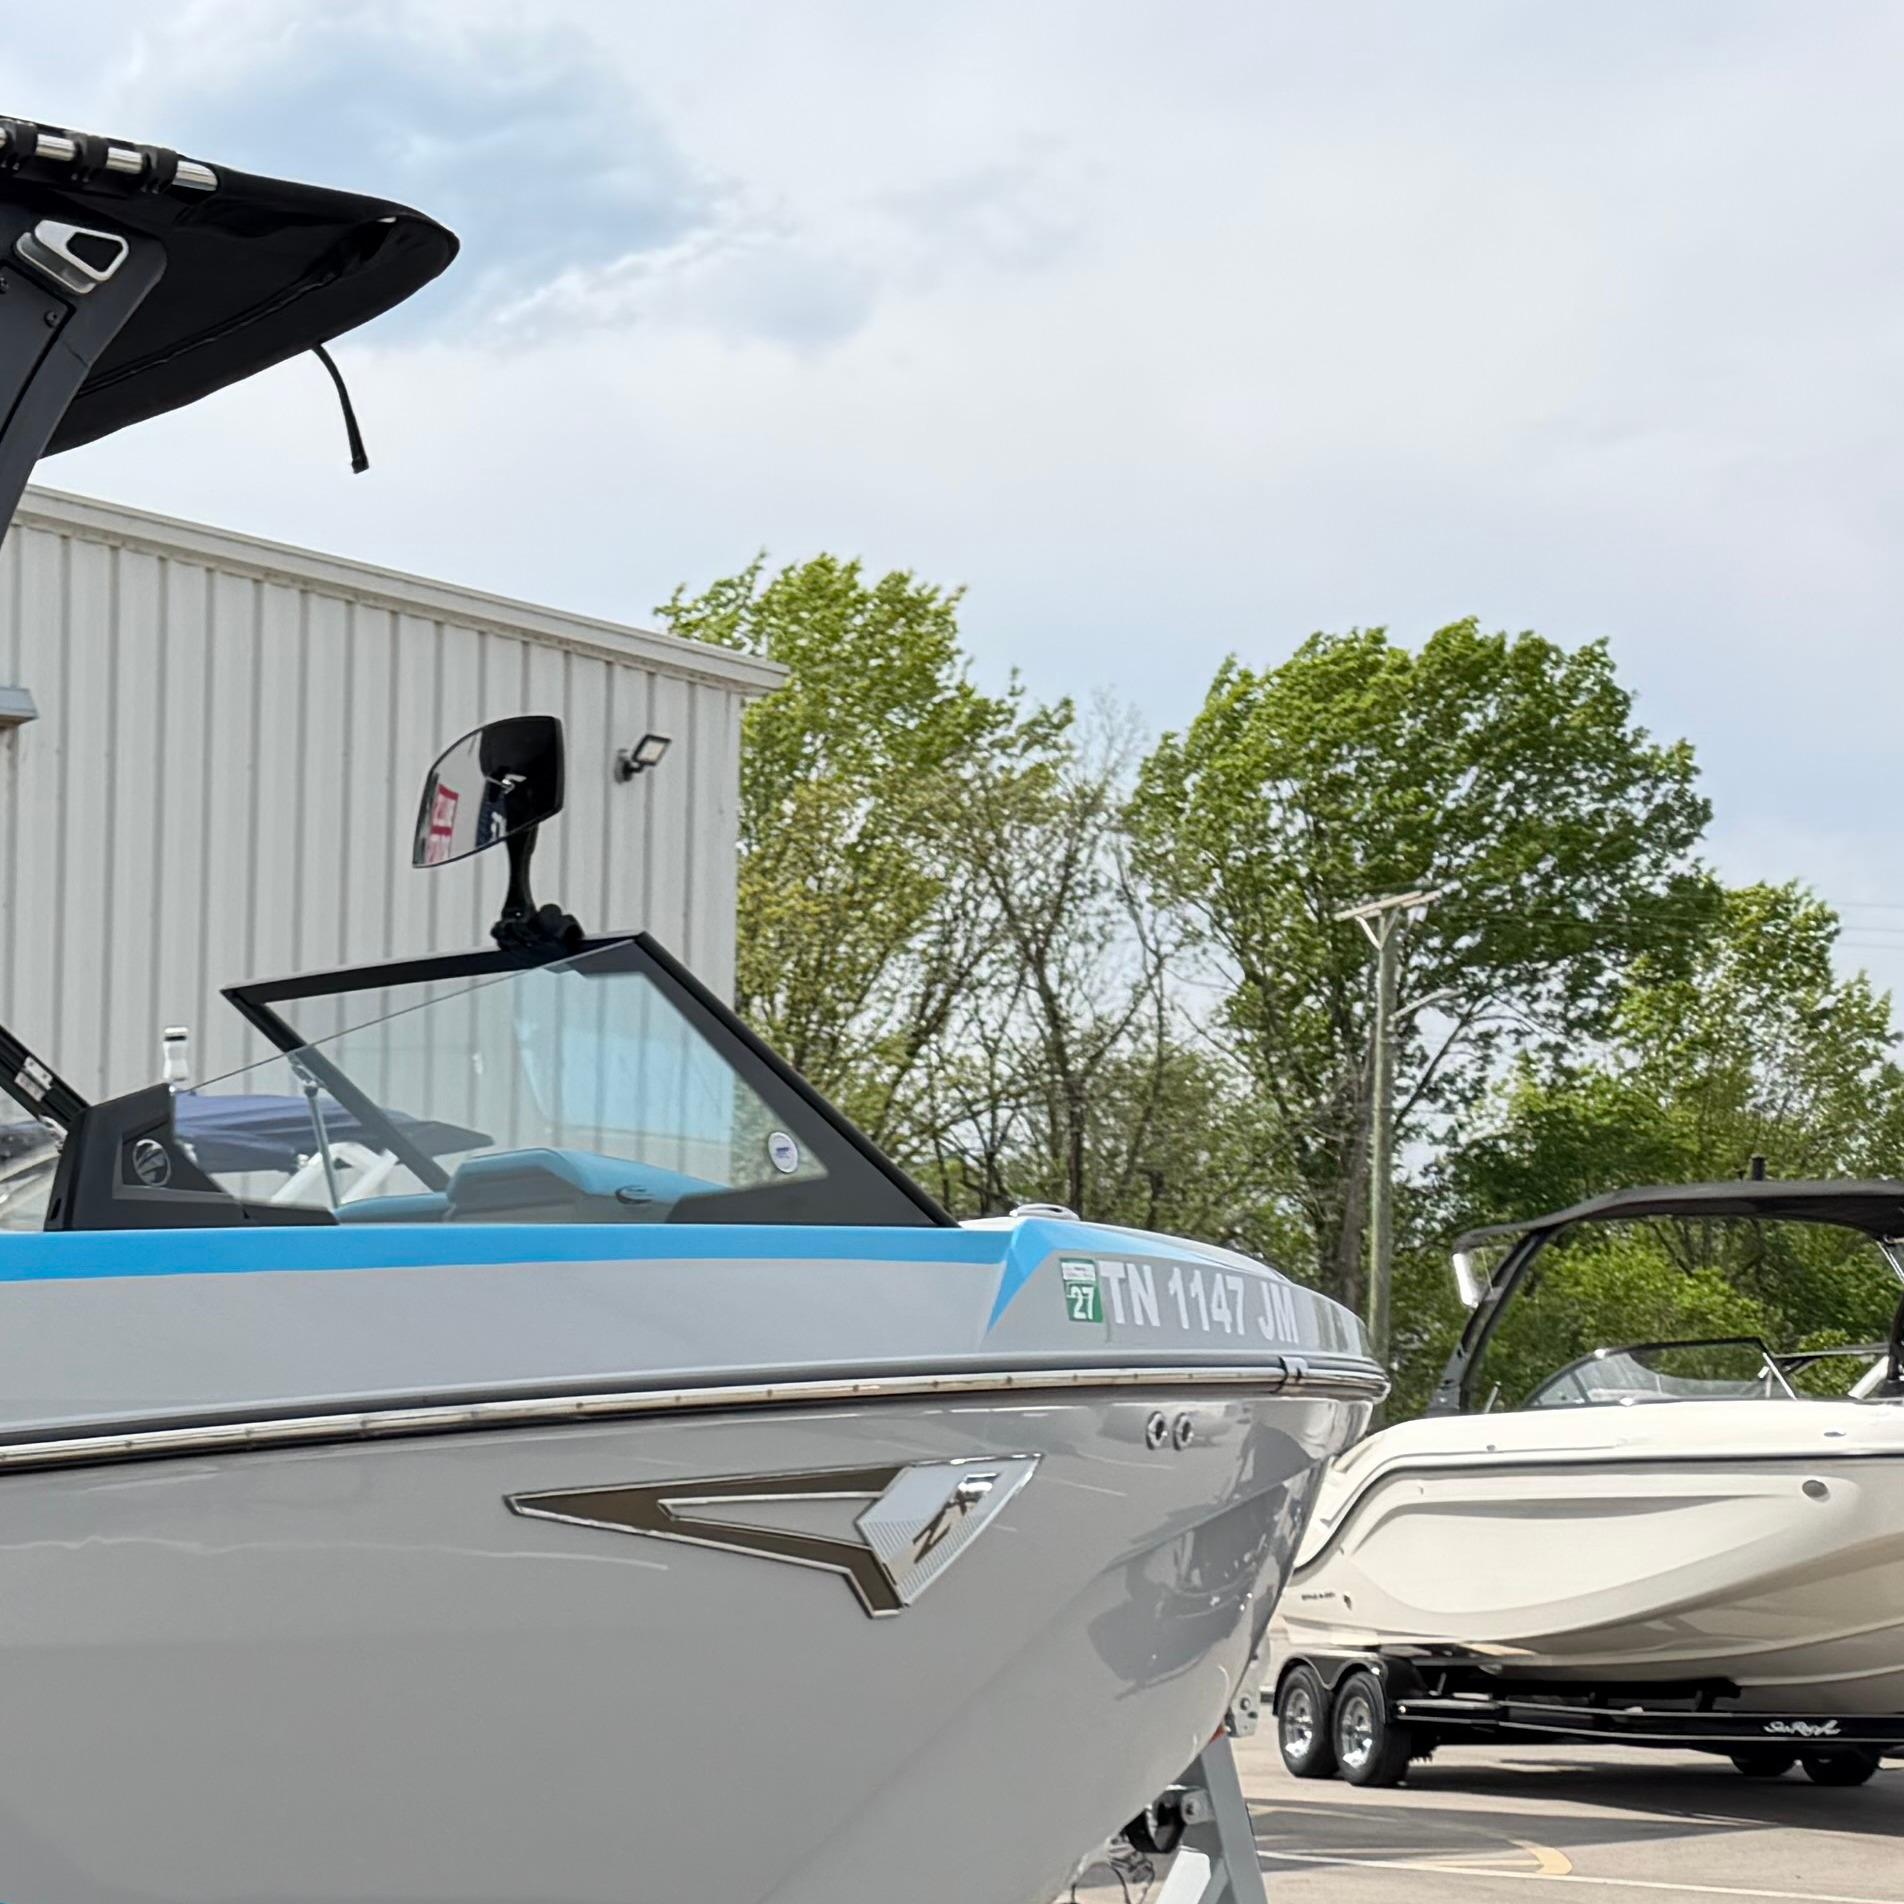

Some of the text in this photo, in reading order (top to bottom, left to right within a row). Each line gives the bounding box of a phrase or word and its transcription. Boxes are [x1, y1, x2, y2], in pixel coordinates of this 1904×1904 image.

[1070, 1285, 1094, 1320] 27
[1098, 1260, 1161, 1327] TN
[1168, 1266, 1245, 1335] 1147
